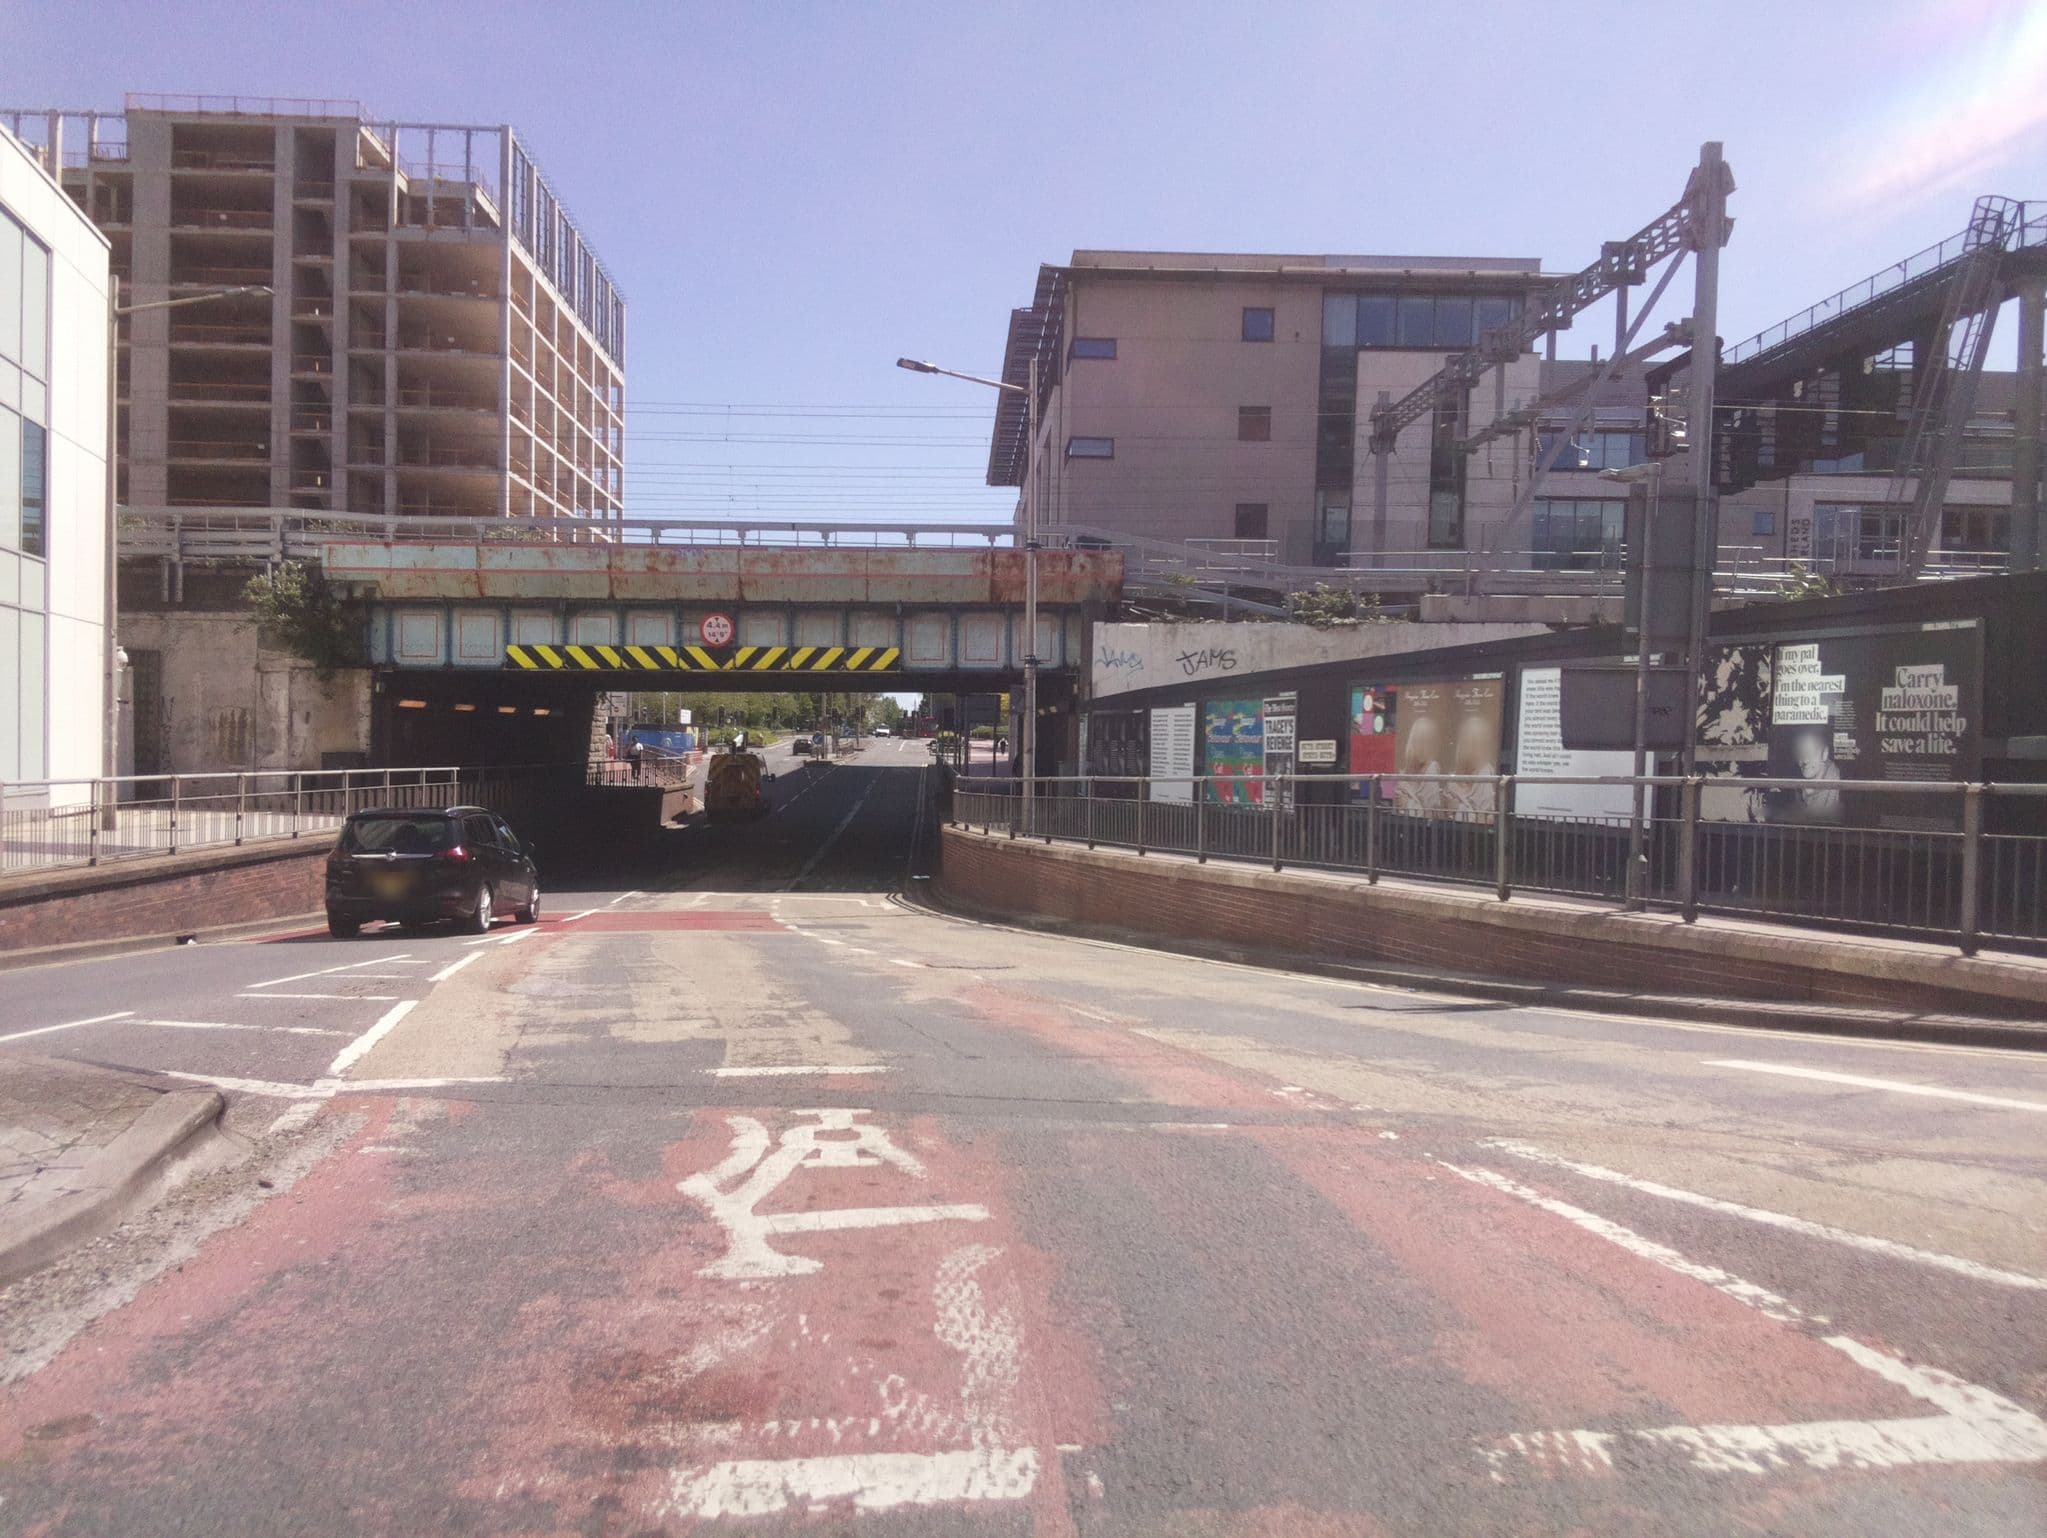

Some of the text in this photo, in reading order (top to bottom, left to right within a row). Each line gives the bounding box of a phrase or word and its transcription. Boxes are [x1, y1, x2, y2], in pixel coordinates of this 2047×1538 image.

[1176, 648, 1237, 675] JAMS
[1785, 650, 1798, 663] my
[1800, 646, 1815, 662] pal
[1776, 664, 1797, 676] goes
[1775, 679, 1843, 692] I'm the nearest
[1897, 667, 1943, 692] Carry
[1775, 693, 1817, 707] thing to a
[1883, 688, 1958, 709] naloxone.
[1774, 707, 1827, 722] paramedic.
[1265, 718, 1294, 734] TRACEY'S
[1875, 711, 1887, 732] It
[1888, 711, 1930, 732] could
[1933, 711, 1967, 736] help
[1266, 735, 1293, 751] REVENGE
[1881, 732, 1957, 754] save a life.
